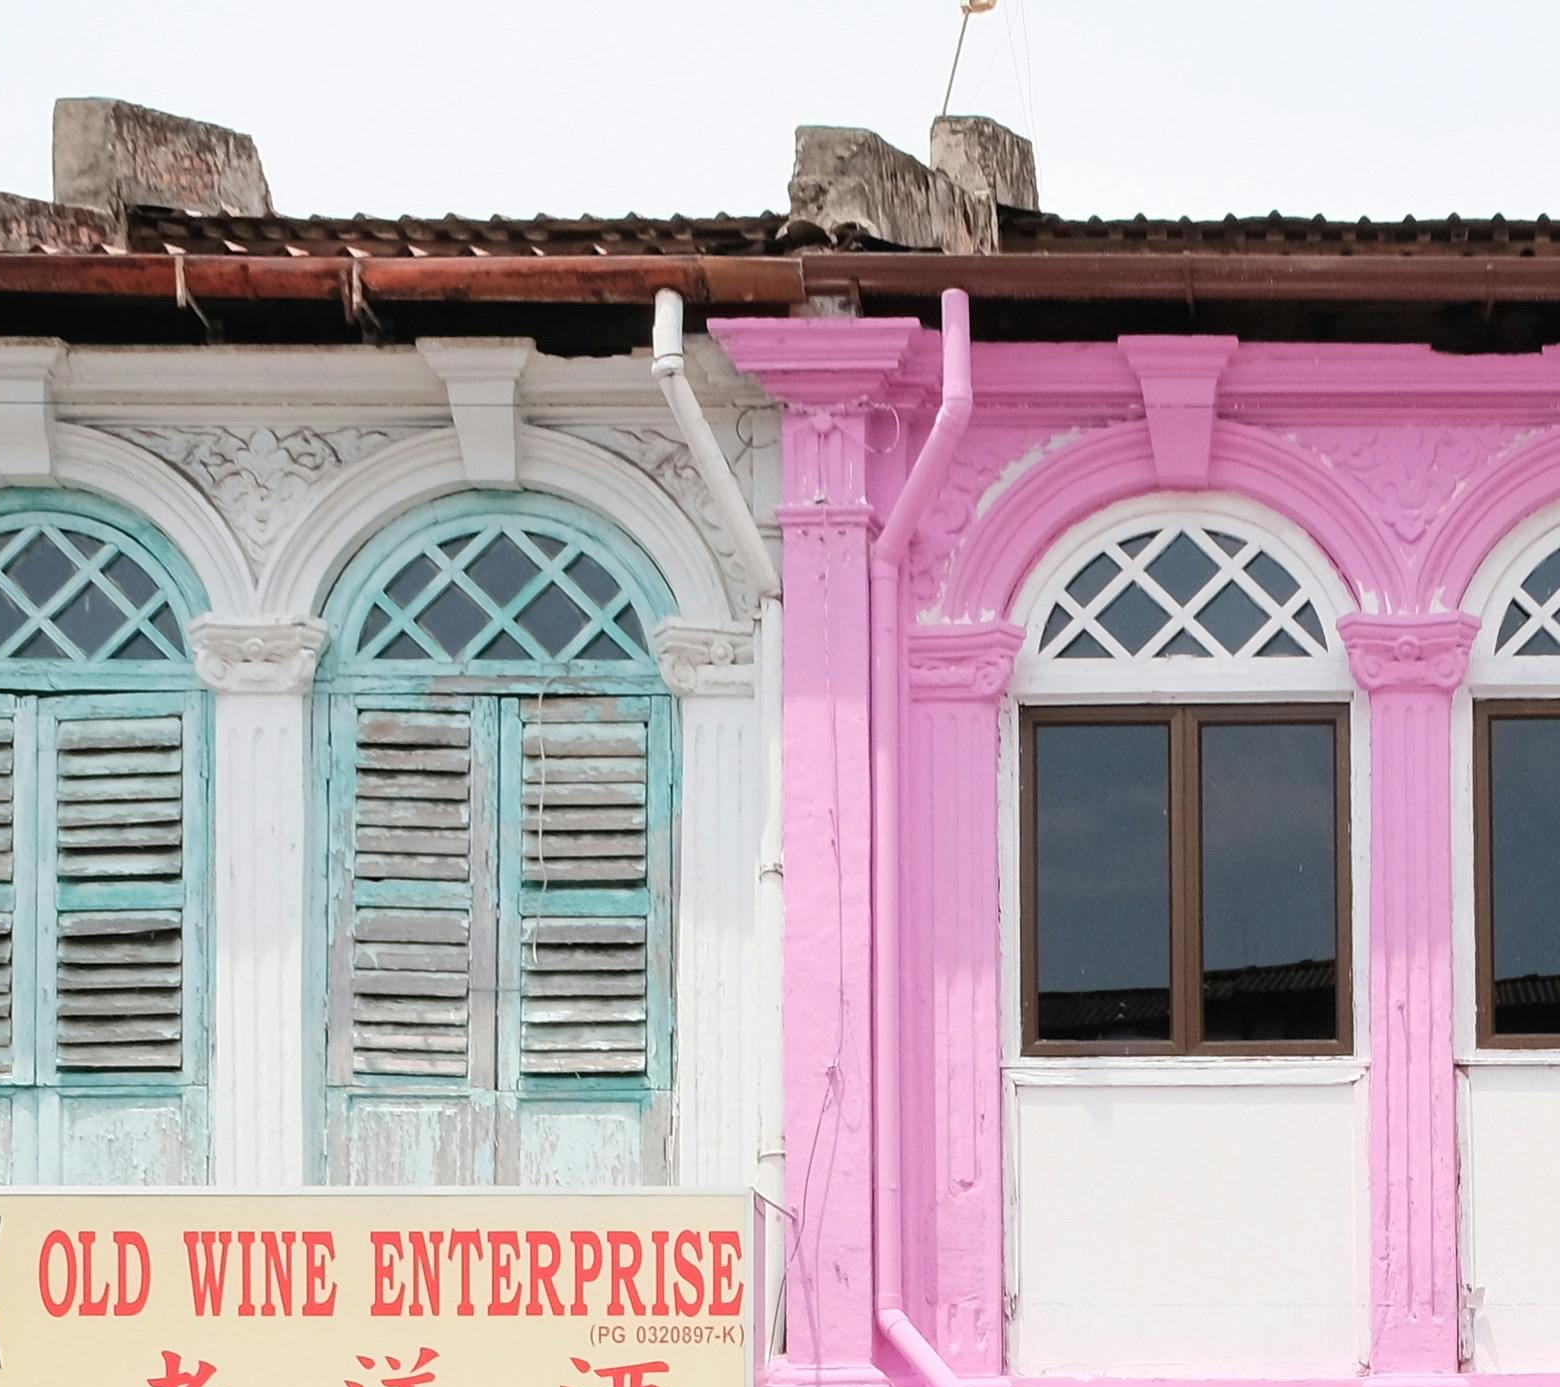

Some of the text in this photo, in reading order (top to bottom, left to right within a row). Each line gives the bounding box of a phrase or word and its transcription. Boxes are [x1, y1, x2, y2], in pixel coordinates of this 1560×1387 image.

[39, 1229, 744, 1317] OLD WINE ENTERPRISE
[590, 1324, 744, 1347] (PG 0320897-K)
